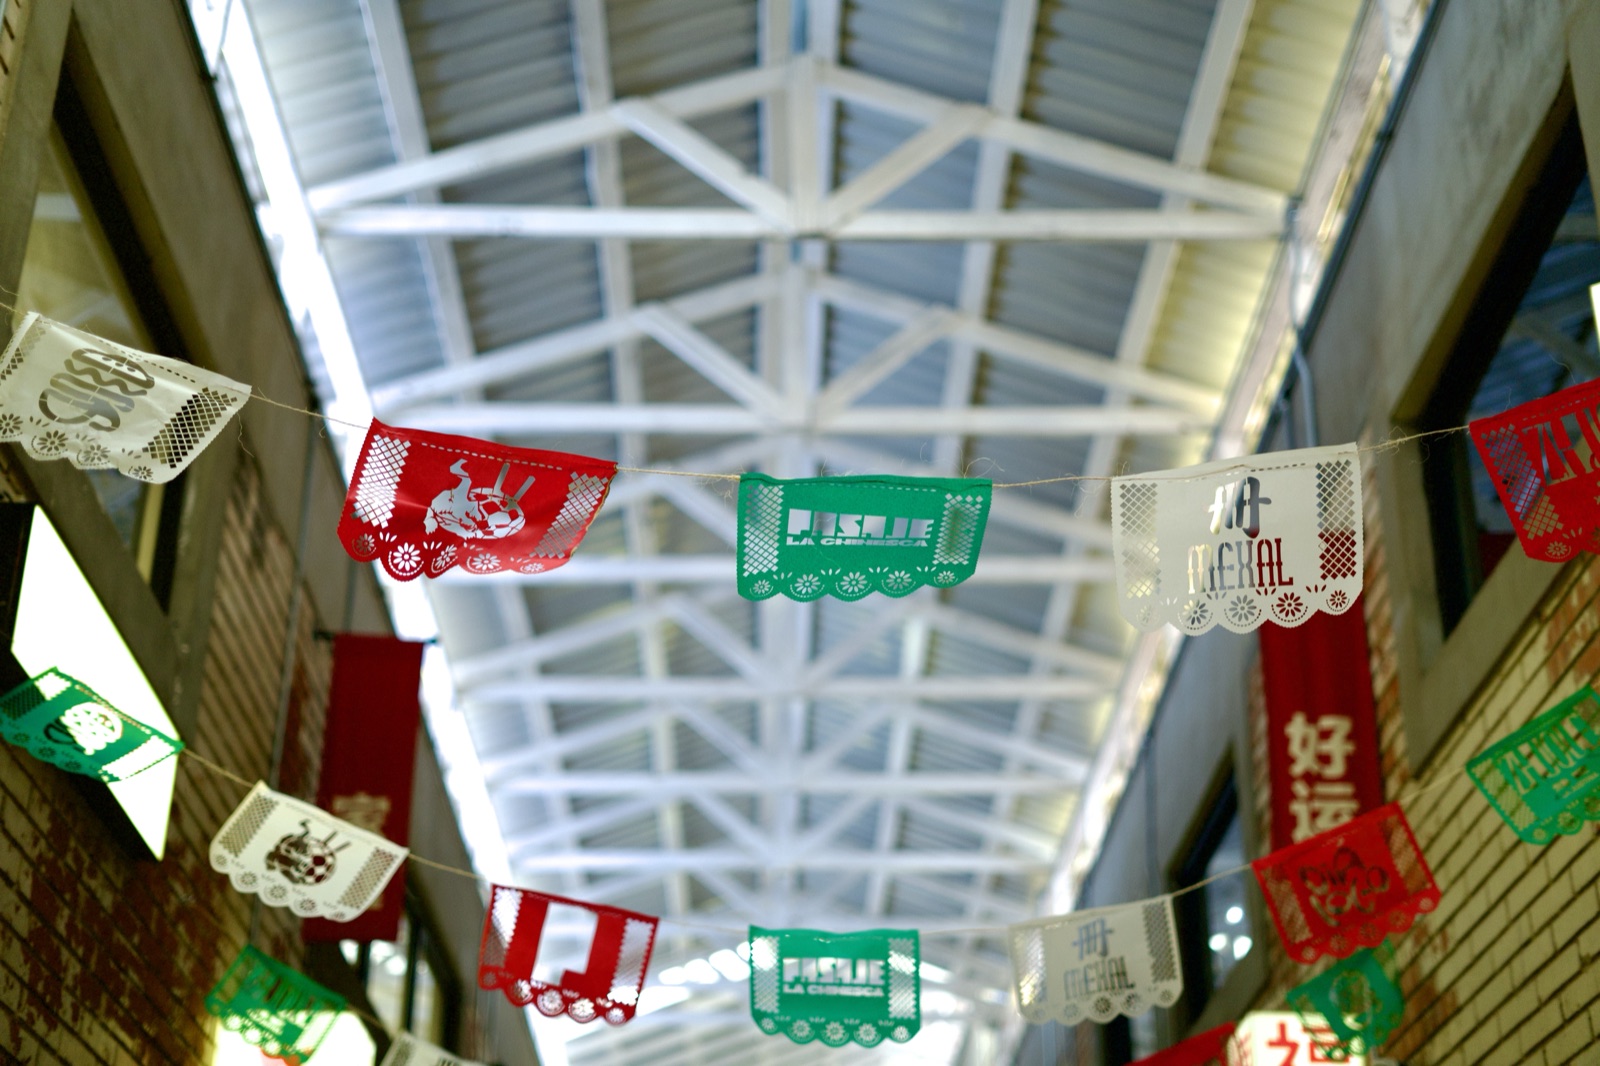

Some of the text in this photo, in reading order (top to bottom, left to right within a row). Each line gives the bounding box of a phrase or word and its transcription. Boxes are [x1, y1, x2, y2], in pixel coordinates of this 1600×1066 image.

[786, 537, 928, 547] LA CHINESCA
[783, 984, 805, 995] LA
